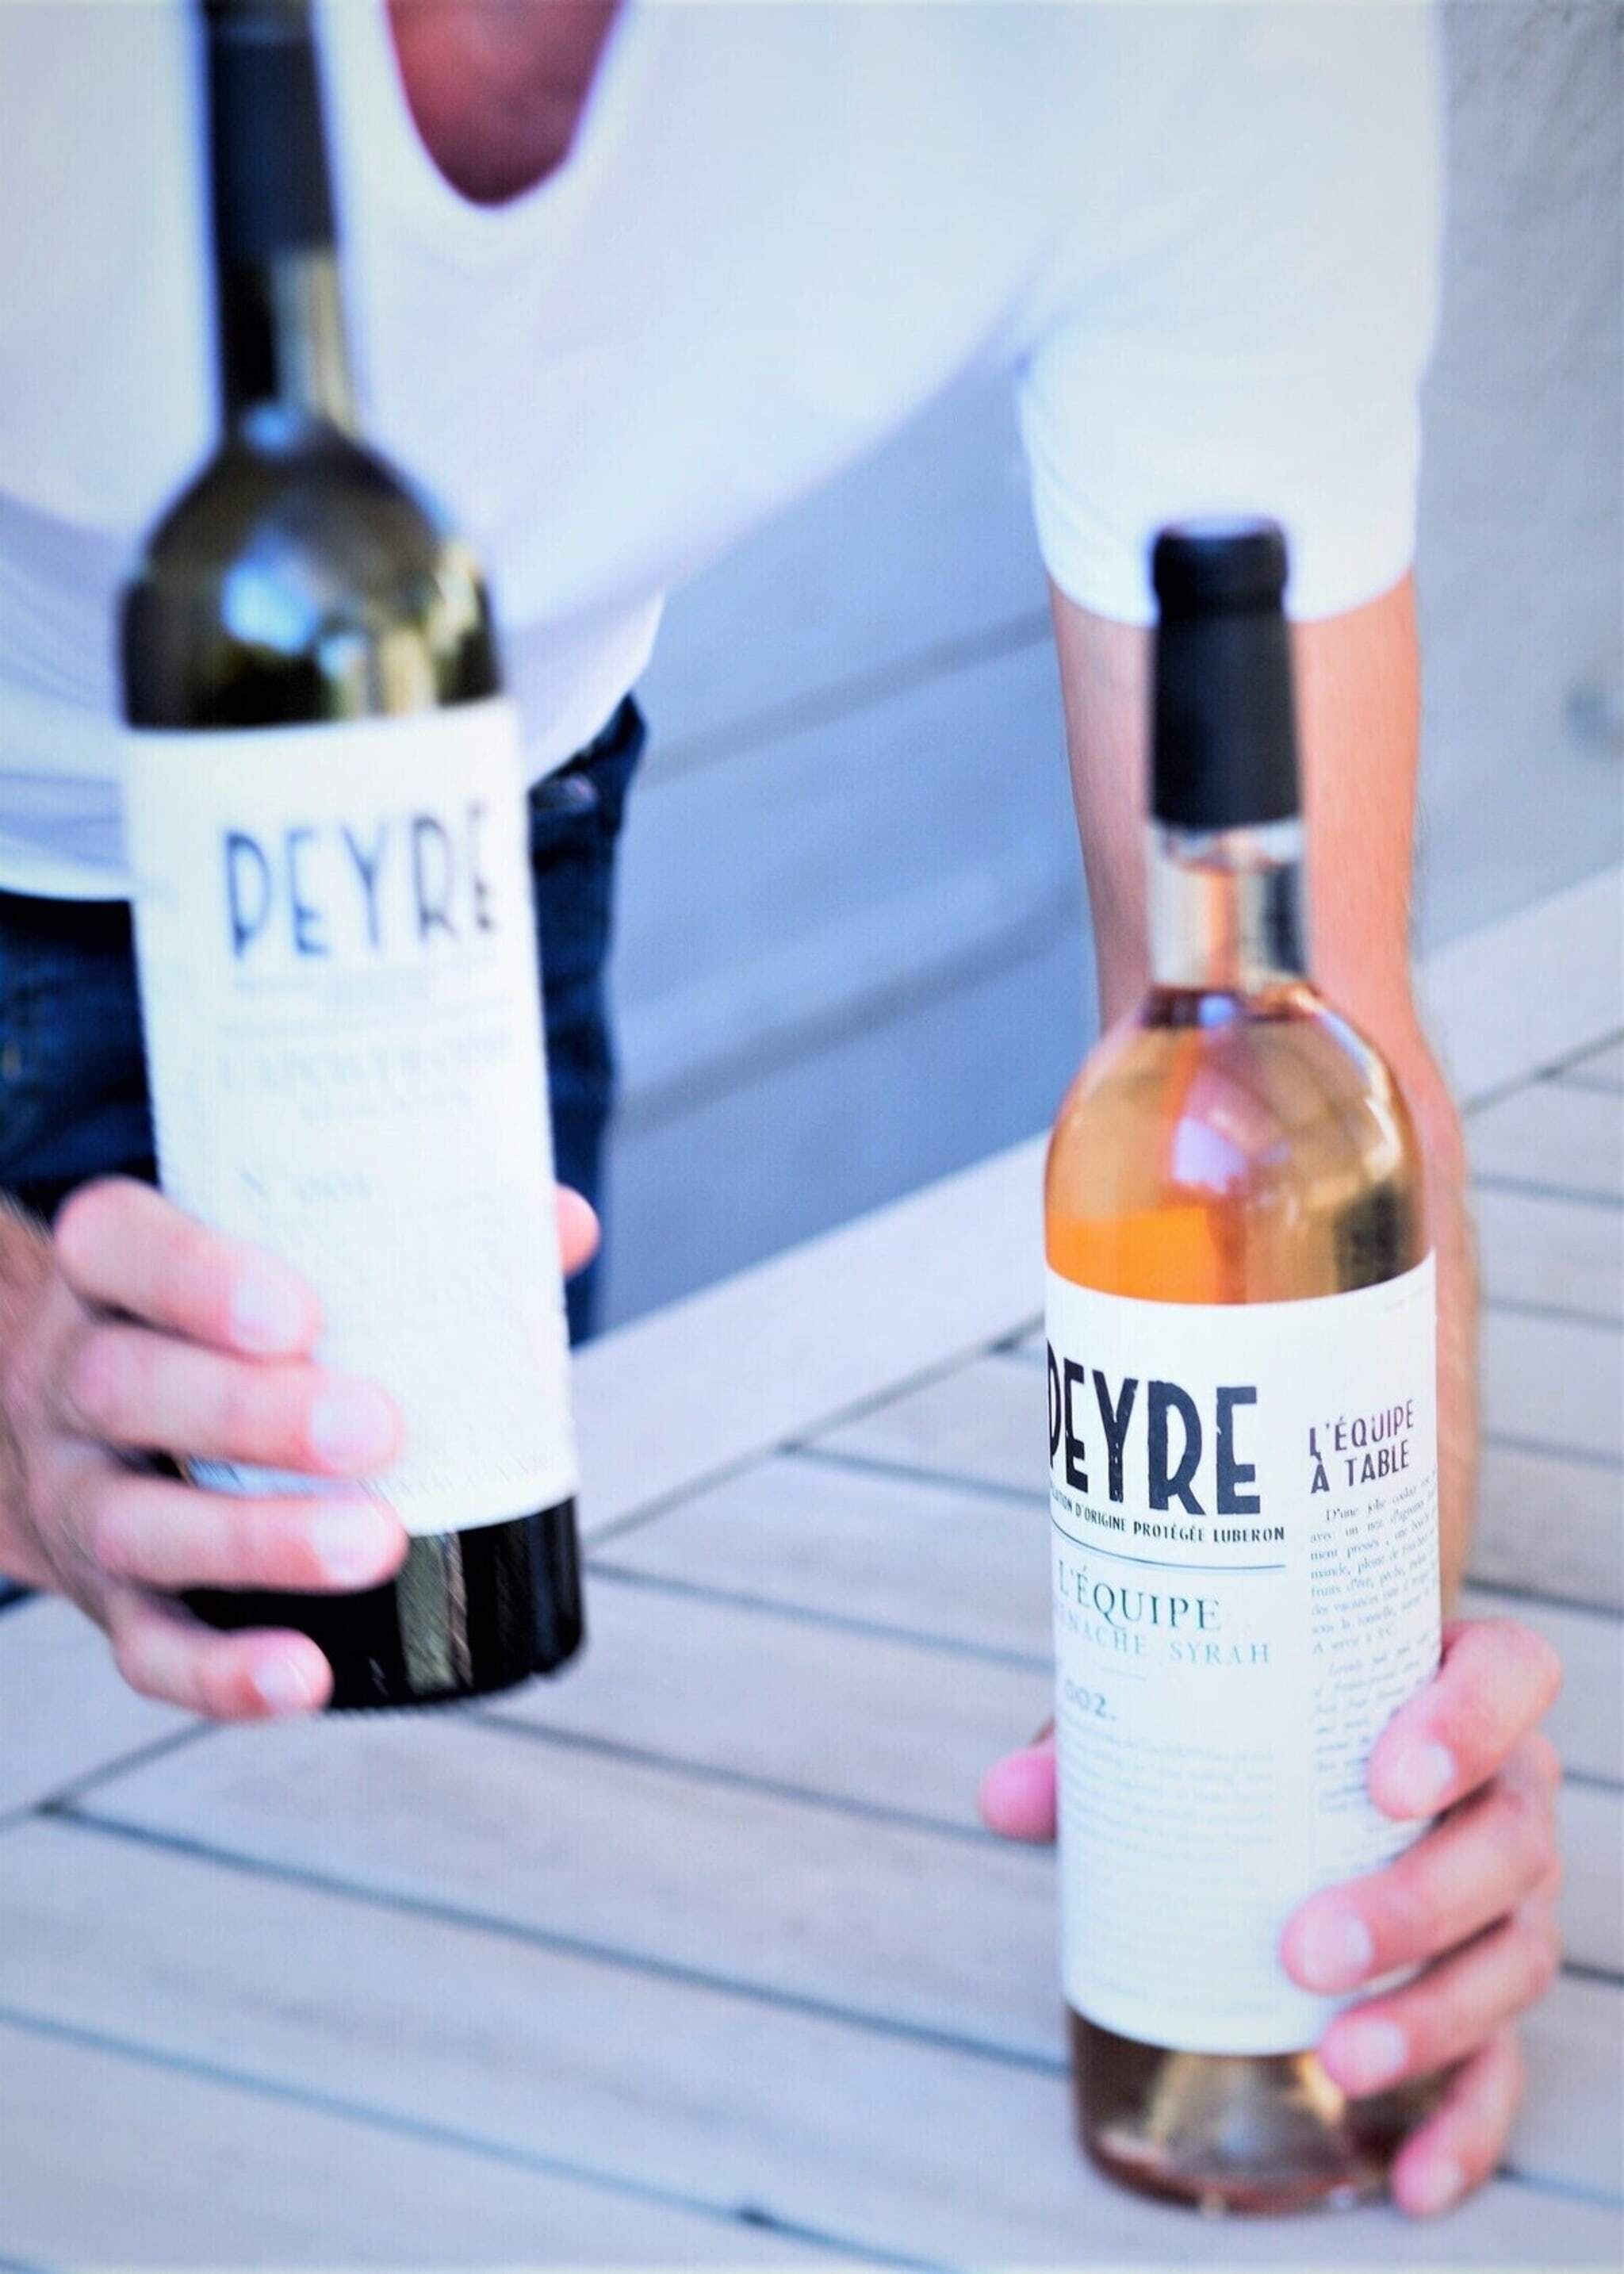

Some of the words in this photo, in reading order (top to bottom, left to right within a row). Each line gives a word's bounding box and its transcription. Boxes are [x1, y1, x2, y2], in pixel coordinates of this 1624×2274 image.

[224, 800, 495, 961] PEYRE
[1309, 1399, 1415, 1457] L'ÉQUIPE
[1345, 1439, 1411, 1488] TABLE
[1075, 1502, 1128, 1532] D'ORIGINE
[1133, 1520, 1205, 1543] PROTÉGÉE
[1213, 1526, 1285, 1543] LUBERON
[1059, 1559, 1223, 1631] L'ÉQUIPE
[1067, 1609, 1145, 1655] NACHE
[1170, 1643, 1270, 1664] SYRAH
